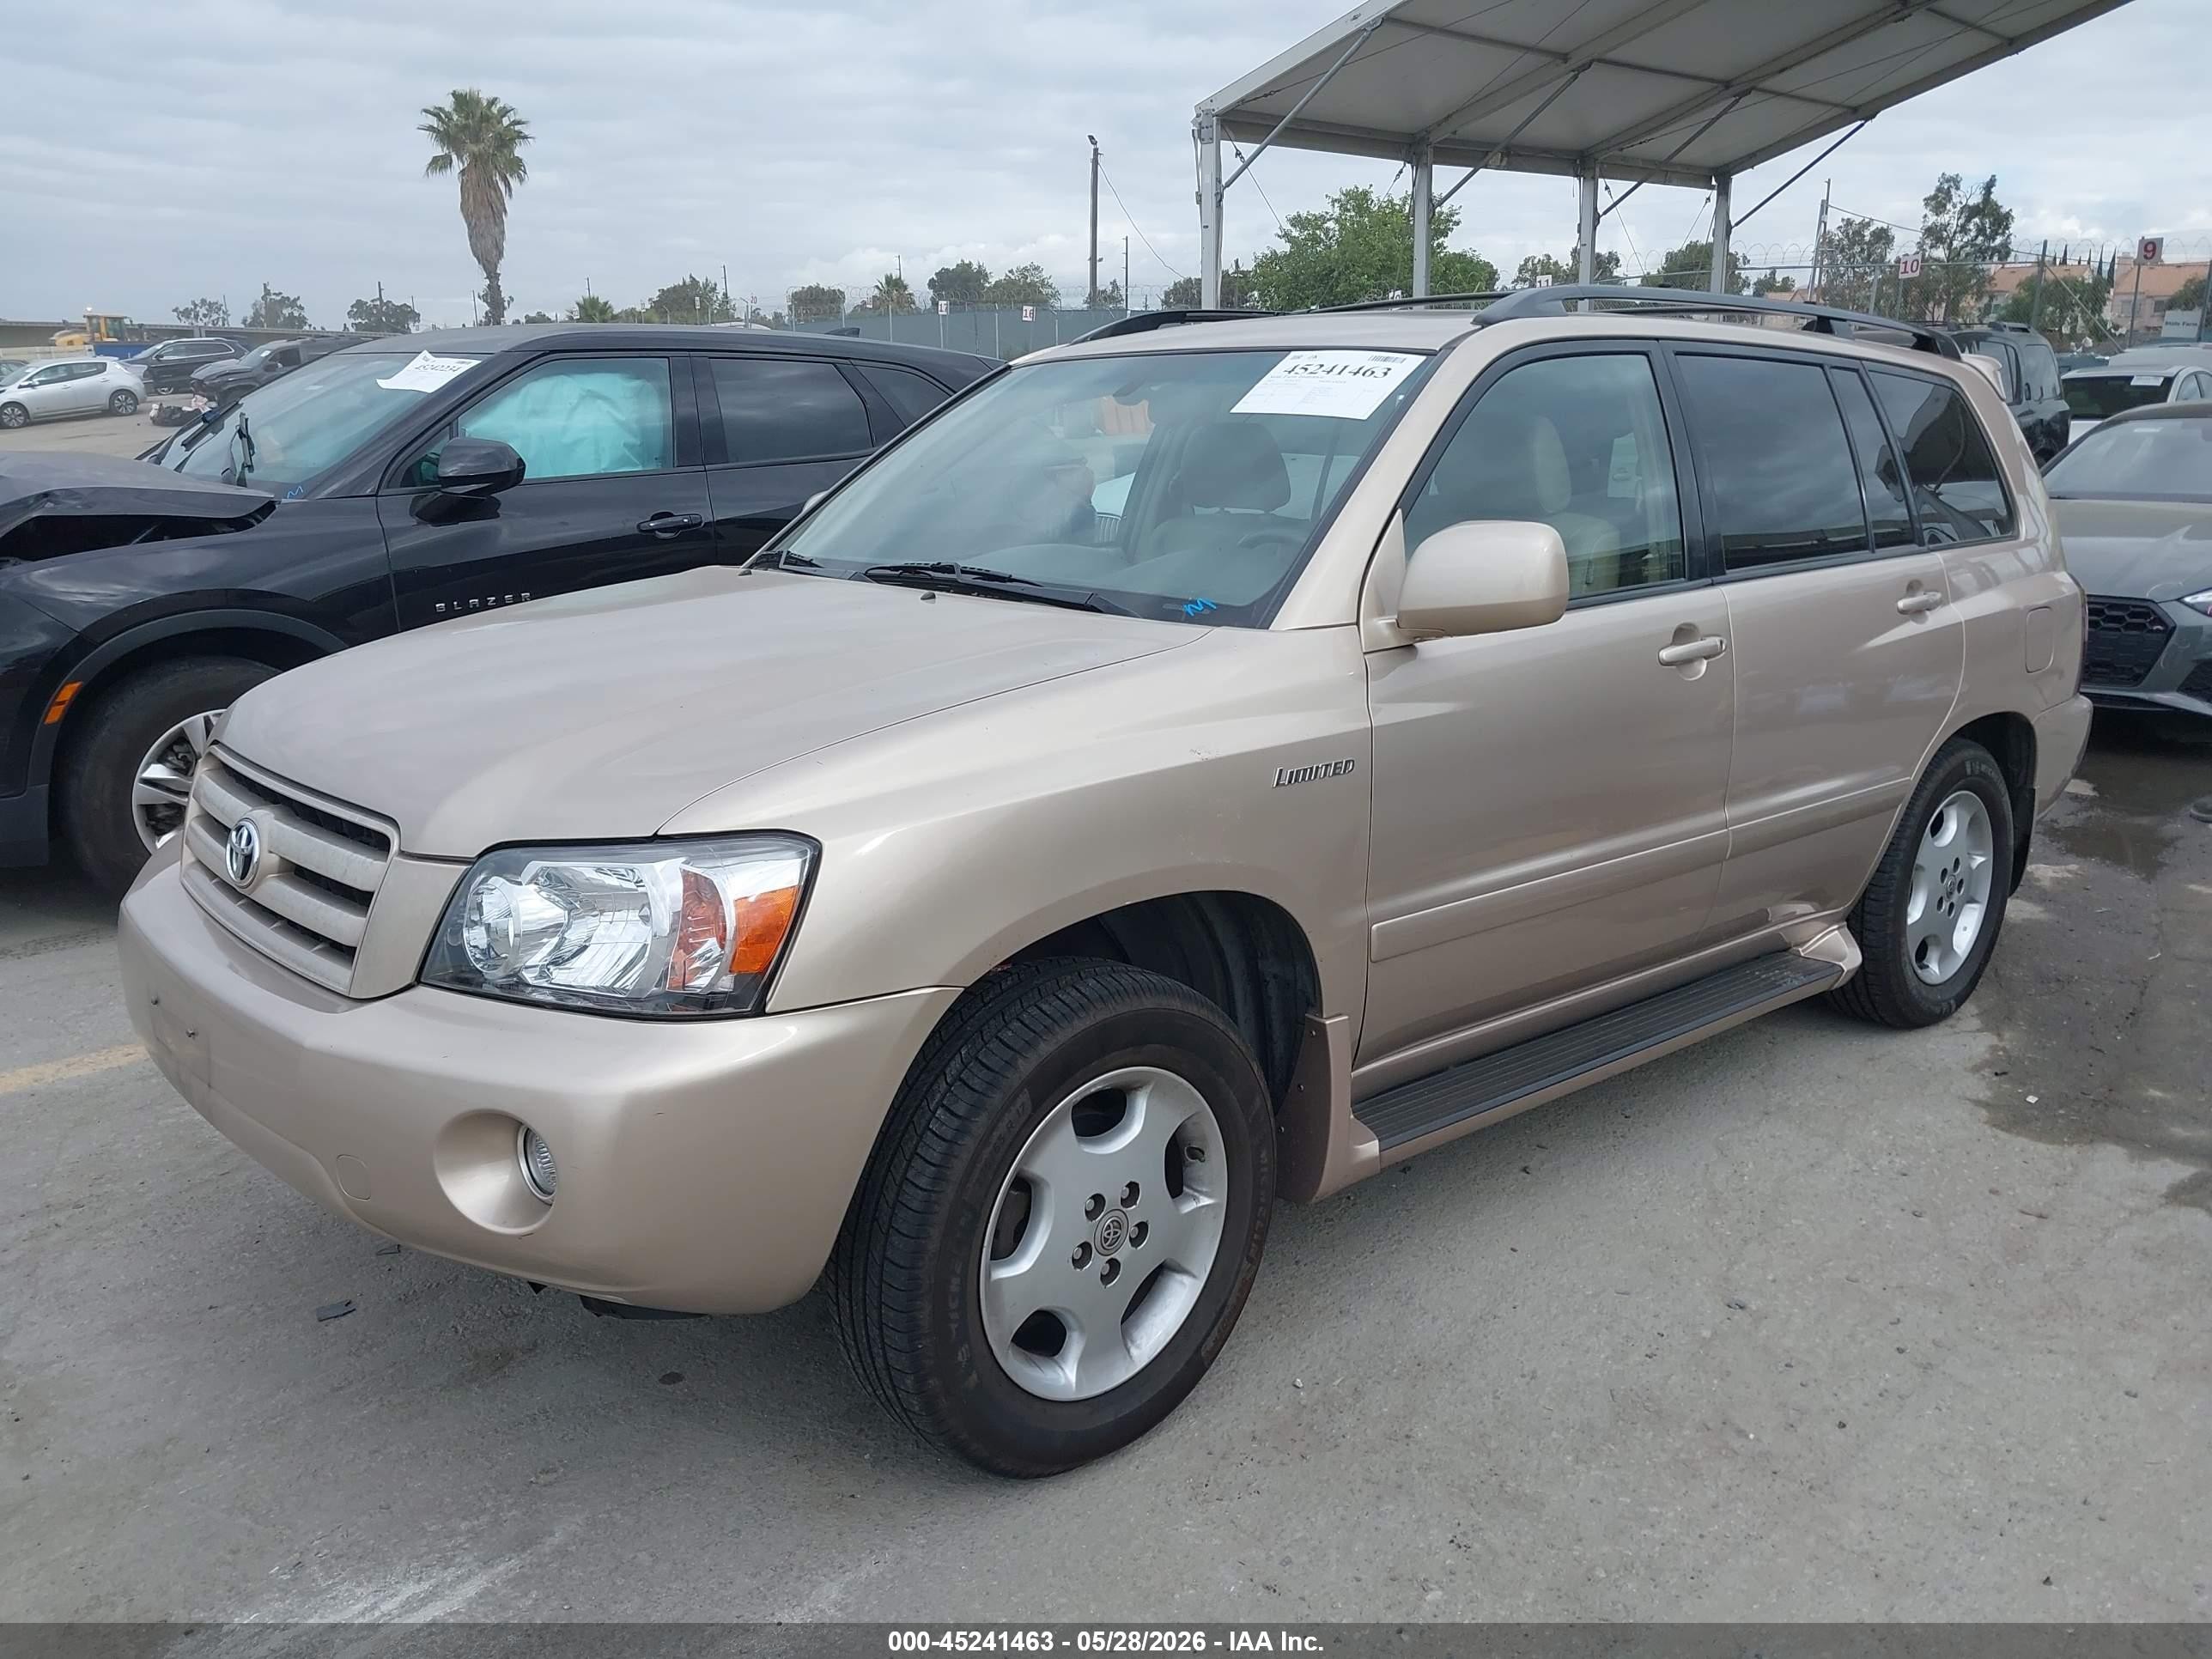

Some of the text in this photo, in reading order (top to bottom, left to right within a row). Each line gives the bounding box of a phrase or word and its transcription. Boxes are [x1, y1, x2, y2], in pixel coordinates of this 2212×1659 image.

[2143, 241, 2156, 260] 9
[1900, 259, 1919, 274] 10
[939, 302, 948, 312] 17
[1023, 308, 1035, 319] 16
[1283, 363, 1392, 379] 45241463
[435, 592, 531, 612] BLAZER
[1272, 758, 1355, 788] LIMITED
